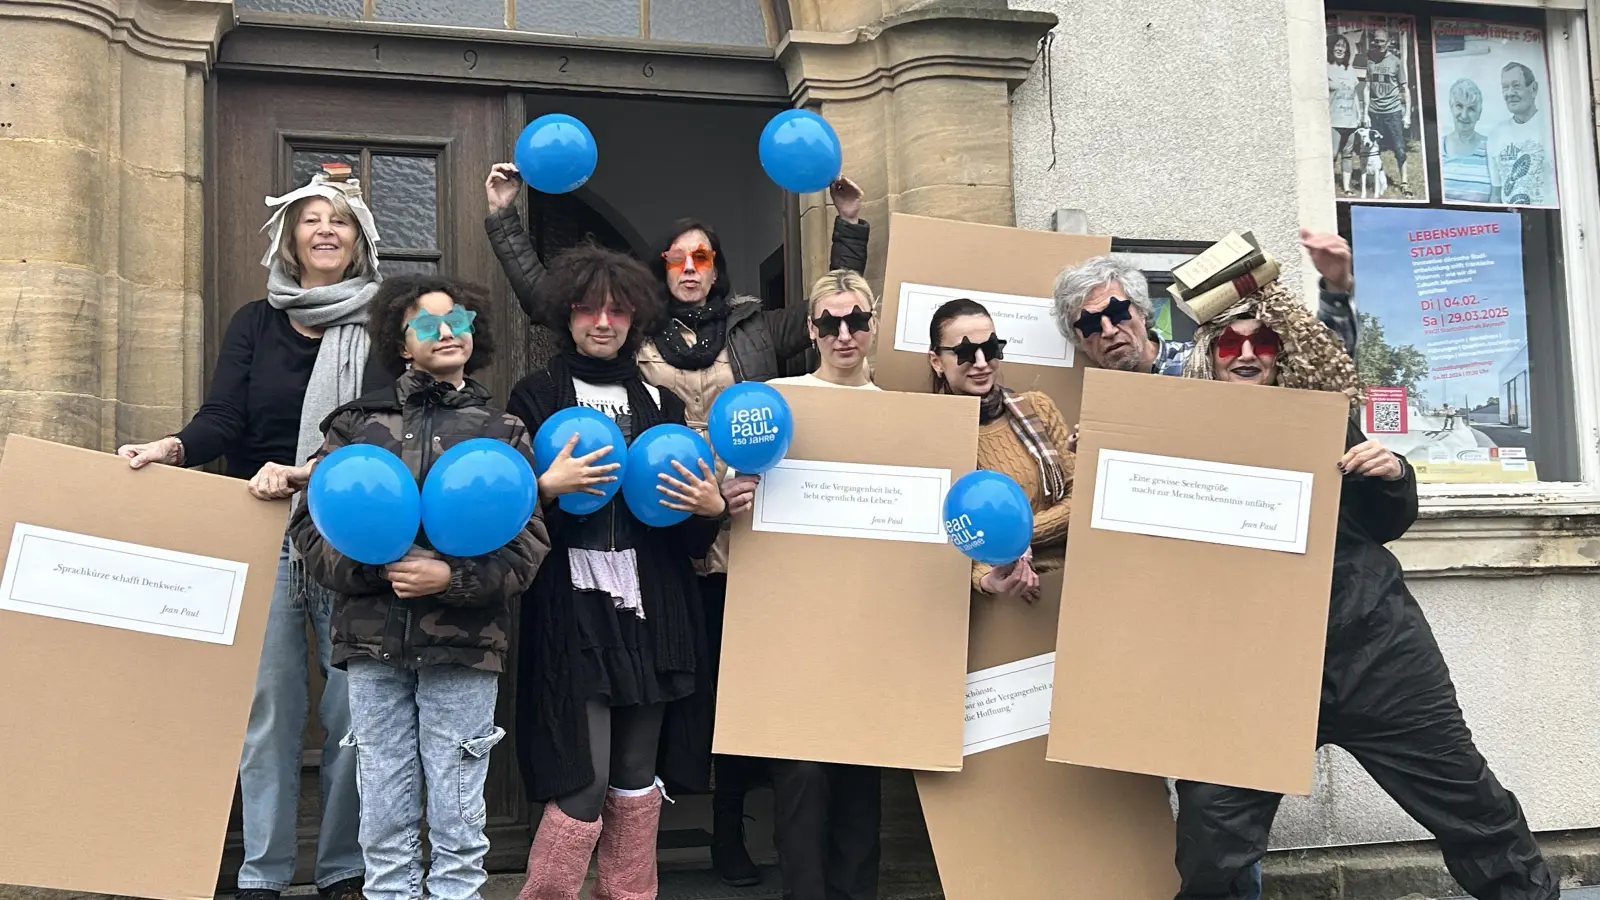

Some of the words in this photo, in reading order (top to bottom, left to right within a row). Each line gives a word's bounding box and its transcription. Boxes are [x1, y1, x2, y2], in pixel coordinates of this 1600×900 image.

[372, 43, 381, 61] 1
[463, 49, 478, 70] 9
[558, 55, 569, 73] 2
[643, 62, 654, 78] 6
[1408, 223, 1500, 242] LEBENSWERTE
[1410, 244, 1451, 258] STADT
[1420, 299, 1434, 311] Di
[1444, 295, 1480, 308] 04.02.
[1016, 313, 1038, 321] Leiden
[1422, 316, 1438, 327] Sa
[1447, 307, 1509, 324] 29.03.2025
[1008, 336, 1024, 344] Paul
[733, 437, 747, 445] 250
[820, 482, 831, 490] die
[832, 483, 883, 495] Vergangenheit
[884, 487, 903, 496] liebt,
[1152, 476, 1180, 488] gewisse
[1181, 479, 1229, 493] Seelengröße
[803, 491, 819, 500] liebt
[820, 492, 856, 503] eigentlich
[857, 495, 869, 503] das
[1131, 485, 1155, 496] macht
[1157, 489, 1170, 497] zur
[1171, 489, 1243, 506] Menschenkenntnis
[870, 516, 886, 526] Jean
[887, 517, 903, 525] Paul
[945, 513, 972, 534] ean
[1240, 520, 1258, 530] Jean
[1259, 521, 1277, 531] Paul
[112, 573, 139, 586] schafft
[160, 604, 179, 616] Jean
[180, 608, 200, 618] Paul
[965, 702, 975, 711] wir
[985, 697, 997, 705] der
[997, 683, 1047, 701] Vergangenheit
[964, 714, 976, 722] die
